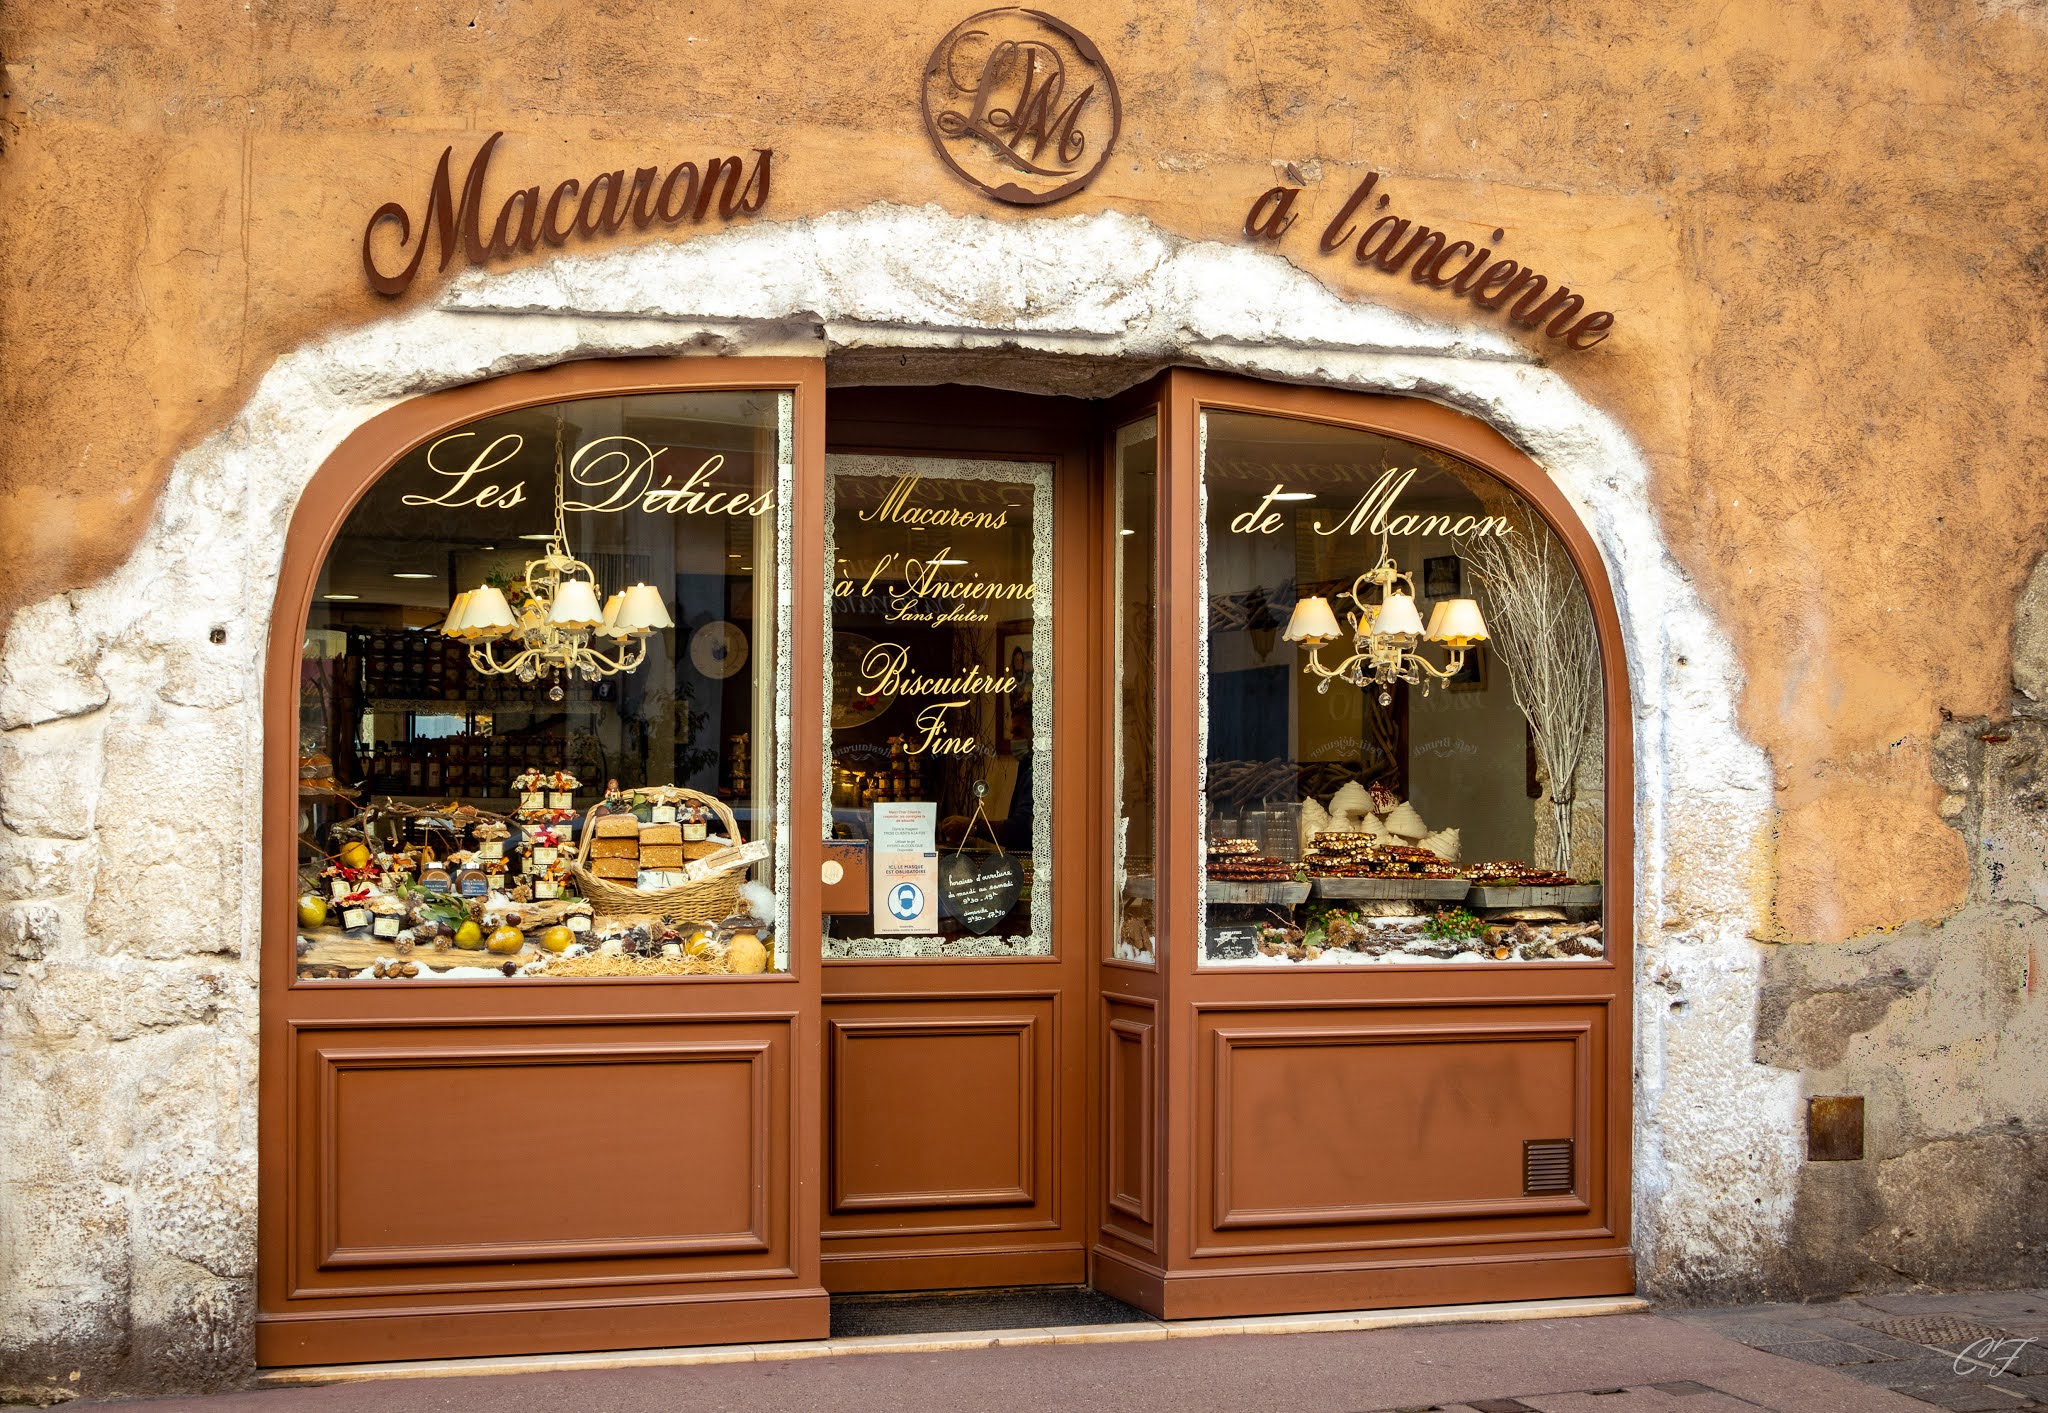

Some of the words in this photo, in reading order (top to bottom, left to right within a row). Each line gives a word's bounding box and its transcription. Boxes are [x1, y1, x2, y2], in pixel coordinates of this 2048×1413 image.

[362, 131, 774, 295] Macarons
[1319, 171, 1615, 351] l'ancienne
[402, 432, 526, 508] Les
[562, 435, 776, 517] Délices
[858, 471, 1008, 530] Macarons
[1231, 483, 1285, 534] de
[1313, 467, 1514, 536] Manon
[834, 567, 855, 598] à
[884, 597, 934, 622] Sans
[931, 603, 990, 629] gluten
[856, 642, 1018, 697] Biscuiterie
[903, 699, 977, 755] Fine
